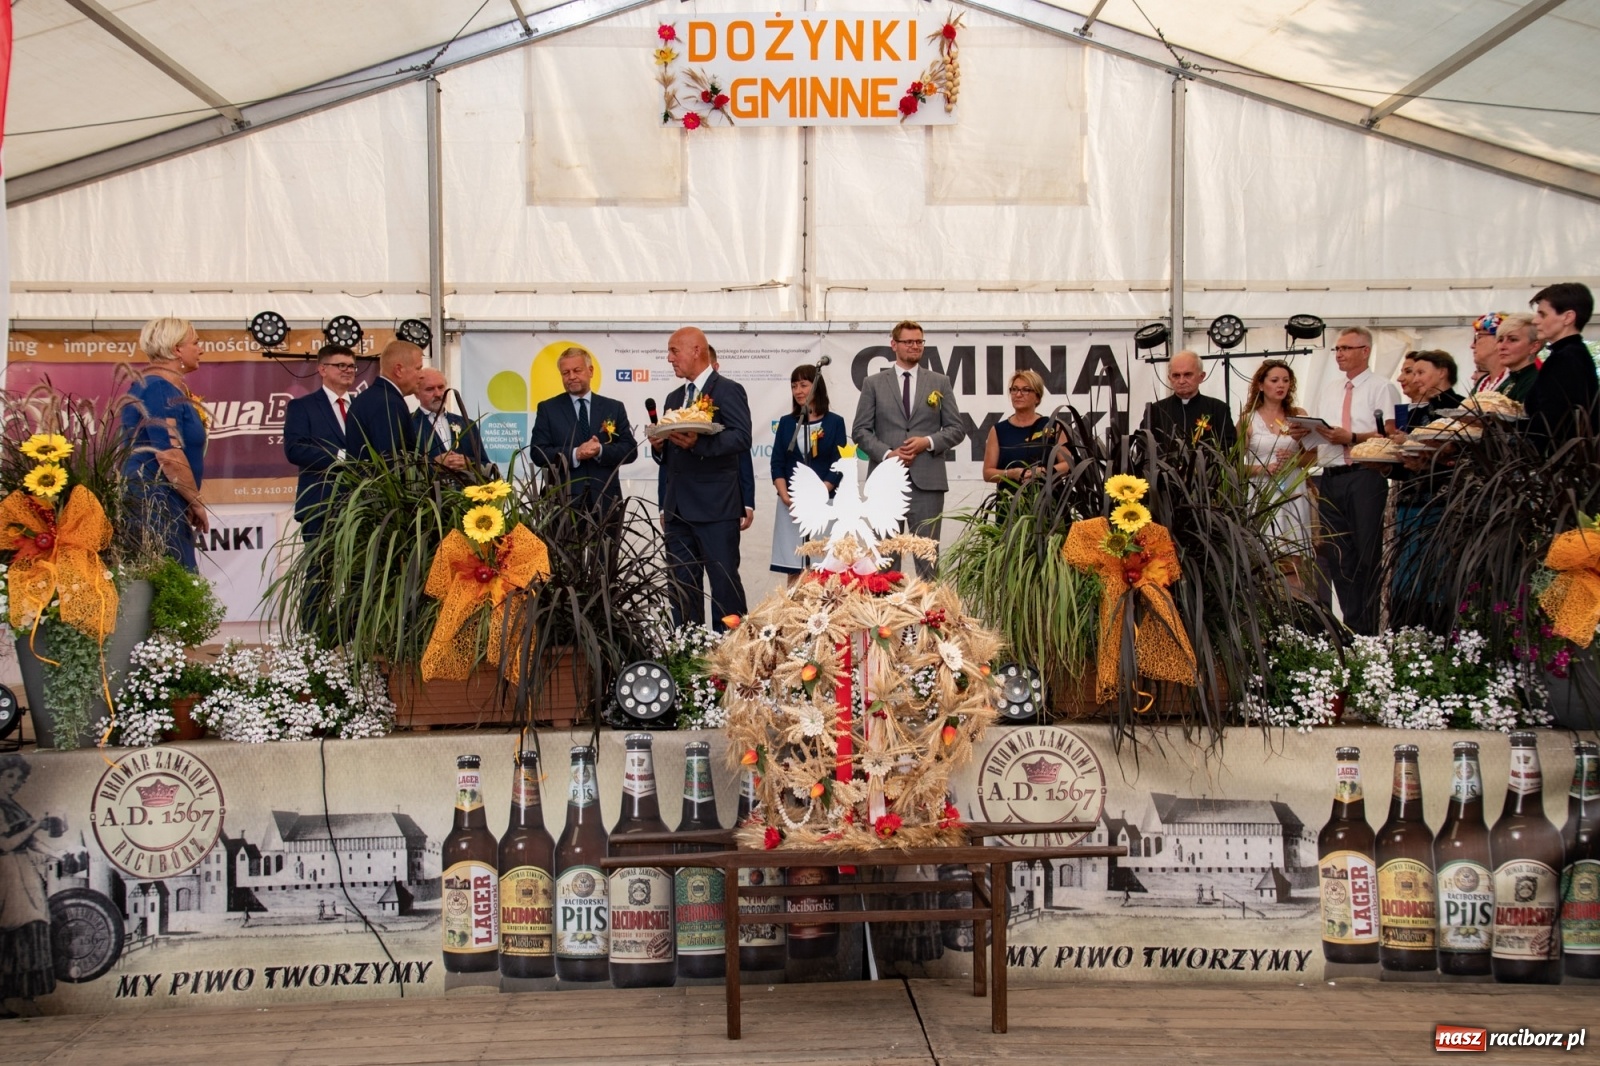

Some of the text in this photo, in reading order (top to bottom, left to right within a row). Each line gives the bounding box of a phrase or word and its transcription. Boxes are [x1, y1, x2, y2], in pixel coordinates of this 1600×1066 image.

[688, 12, 917, 62] DOŻYNKI
[730, 76, 898, 118] GMINNE
[65, 339, 137, 357] imprezy
[851, 345, 1128, 396] GMINA
[234, 487, 249, 495] tel.
[987, 729, 1097, 776] BROWAR ZAMKOWY
[100, 751, 216, 802] BROWAR ZAMKOWY
[458, 776, 479, 784] LAGER
[1338, 767, 1358, 776] LAGER
[986, 776, 1096, 810] A.D. 1567
[100, 798, 215, 832] A.D. 1567
[112, 837, 206, 873] RACIBÓRZ
[474, 874, 492, 944] LAGER
[787, 898, 835, 912] Raciborskie
[1350, 866, 1372, 936] LAGER
[1006, 944, 1312, 972] MY PIWO TWORZYMY
[115, 960, 434, 998] MY PIWO TWORZYMY
